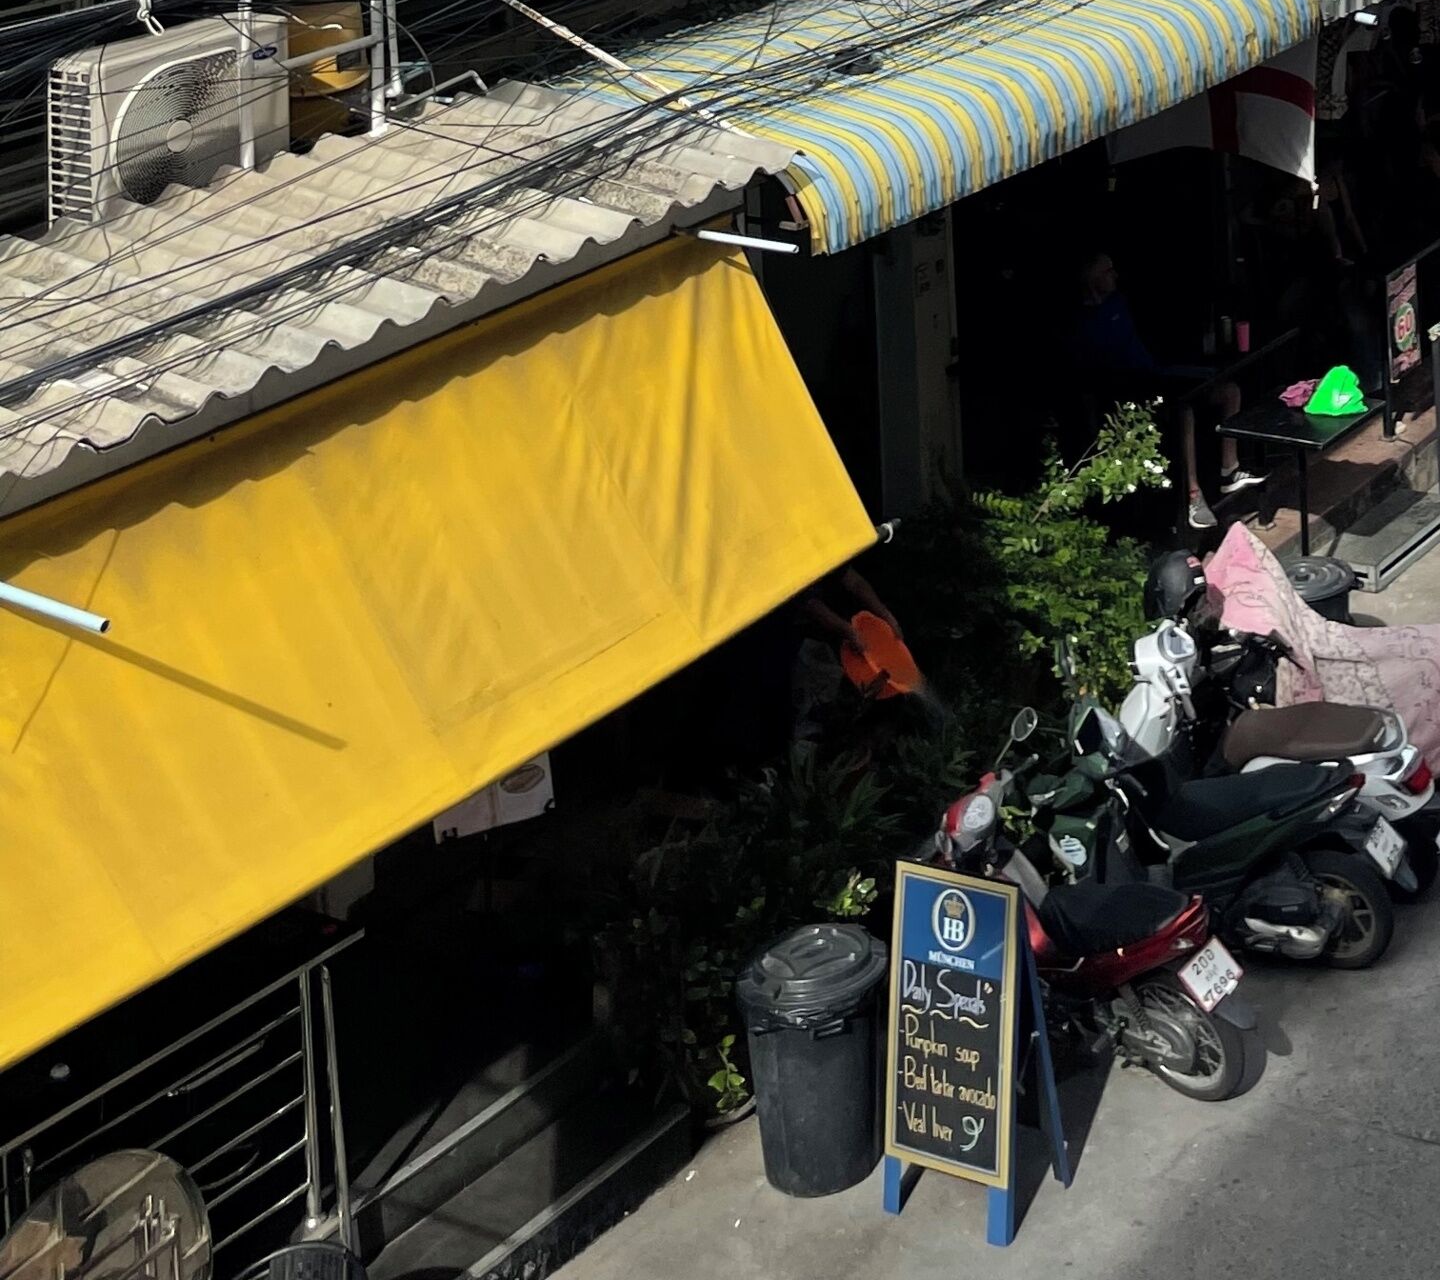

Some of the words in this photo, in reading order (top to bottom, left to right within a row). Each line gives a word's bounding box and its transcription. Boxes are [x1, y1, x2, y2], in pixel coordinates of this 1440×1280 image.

[942, 916, 965, 942] HB
[903, 959, 932, 1015] Daily
[955, 1046, 980, 1072] soup
[958, 1076, 996, 1110] avocado
[932, 1105, 953, 1142] liver
